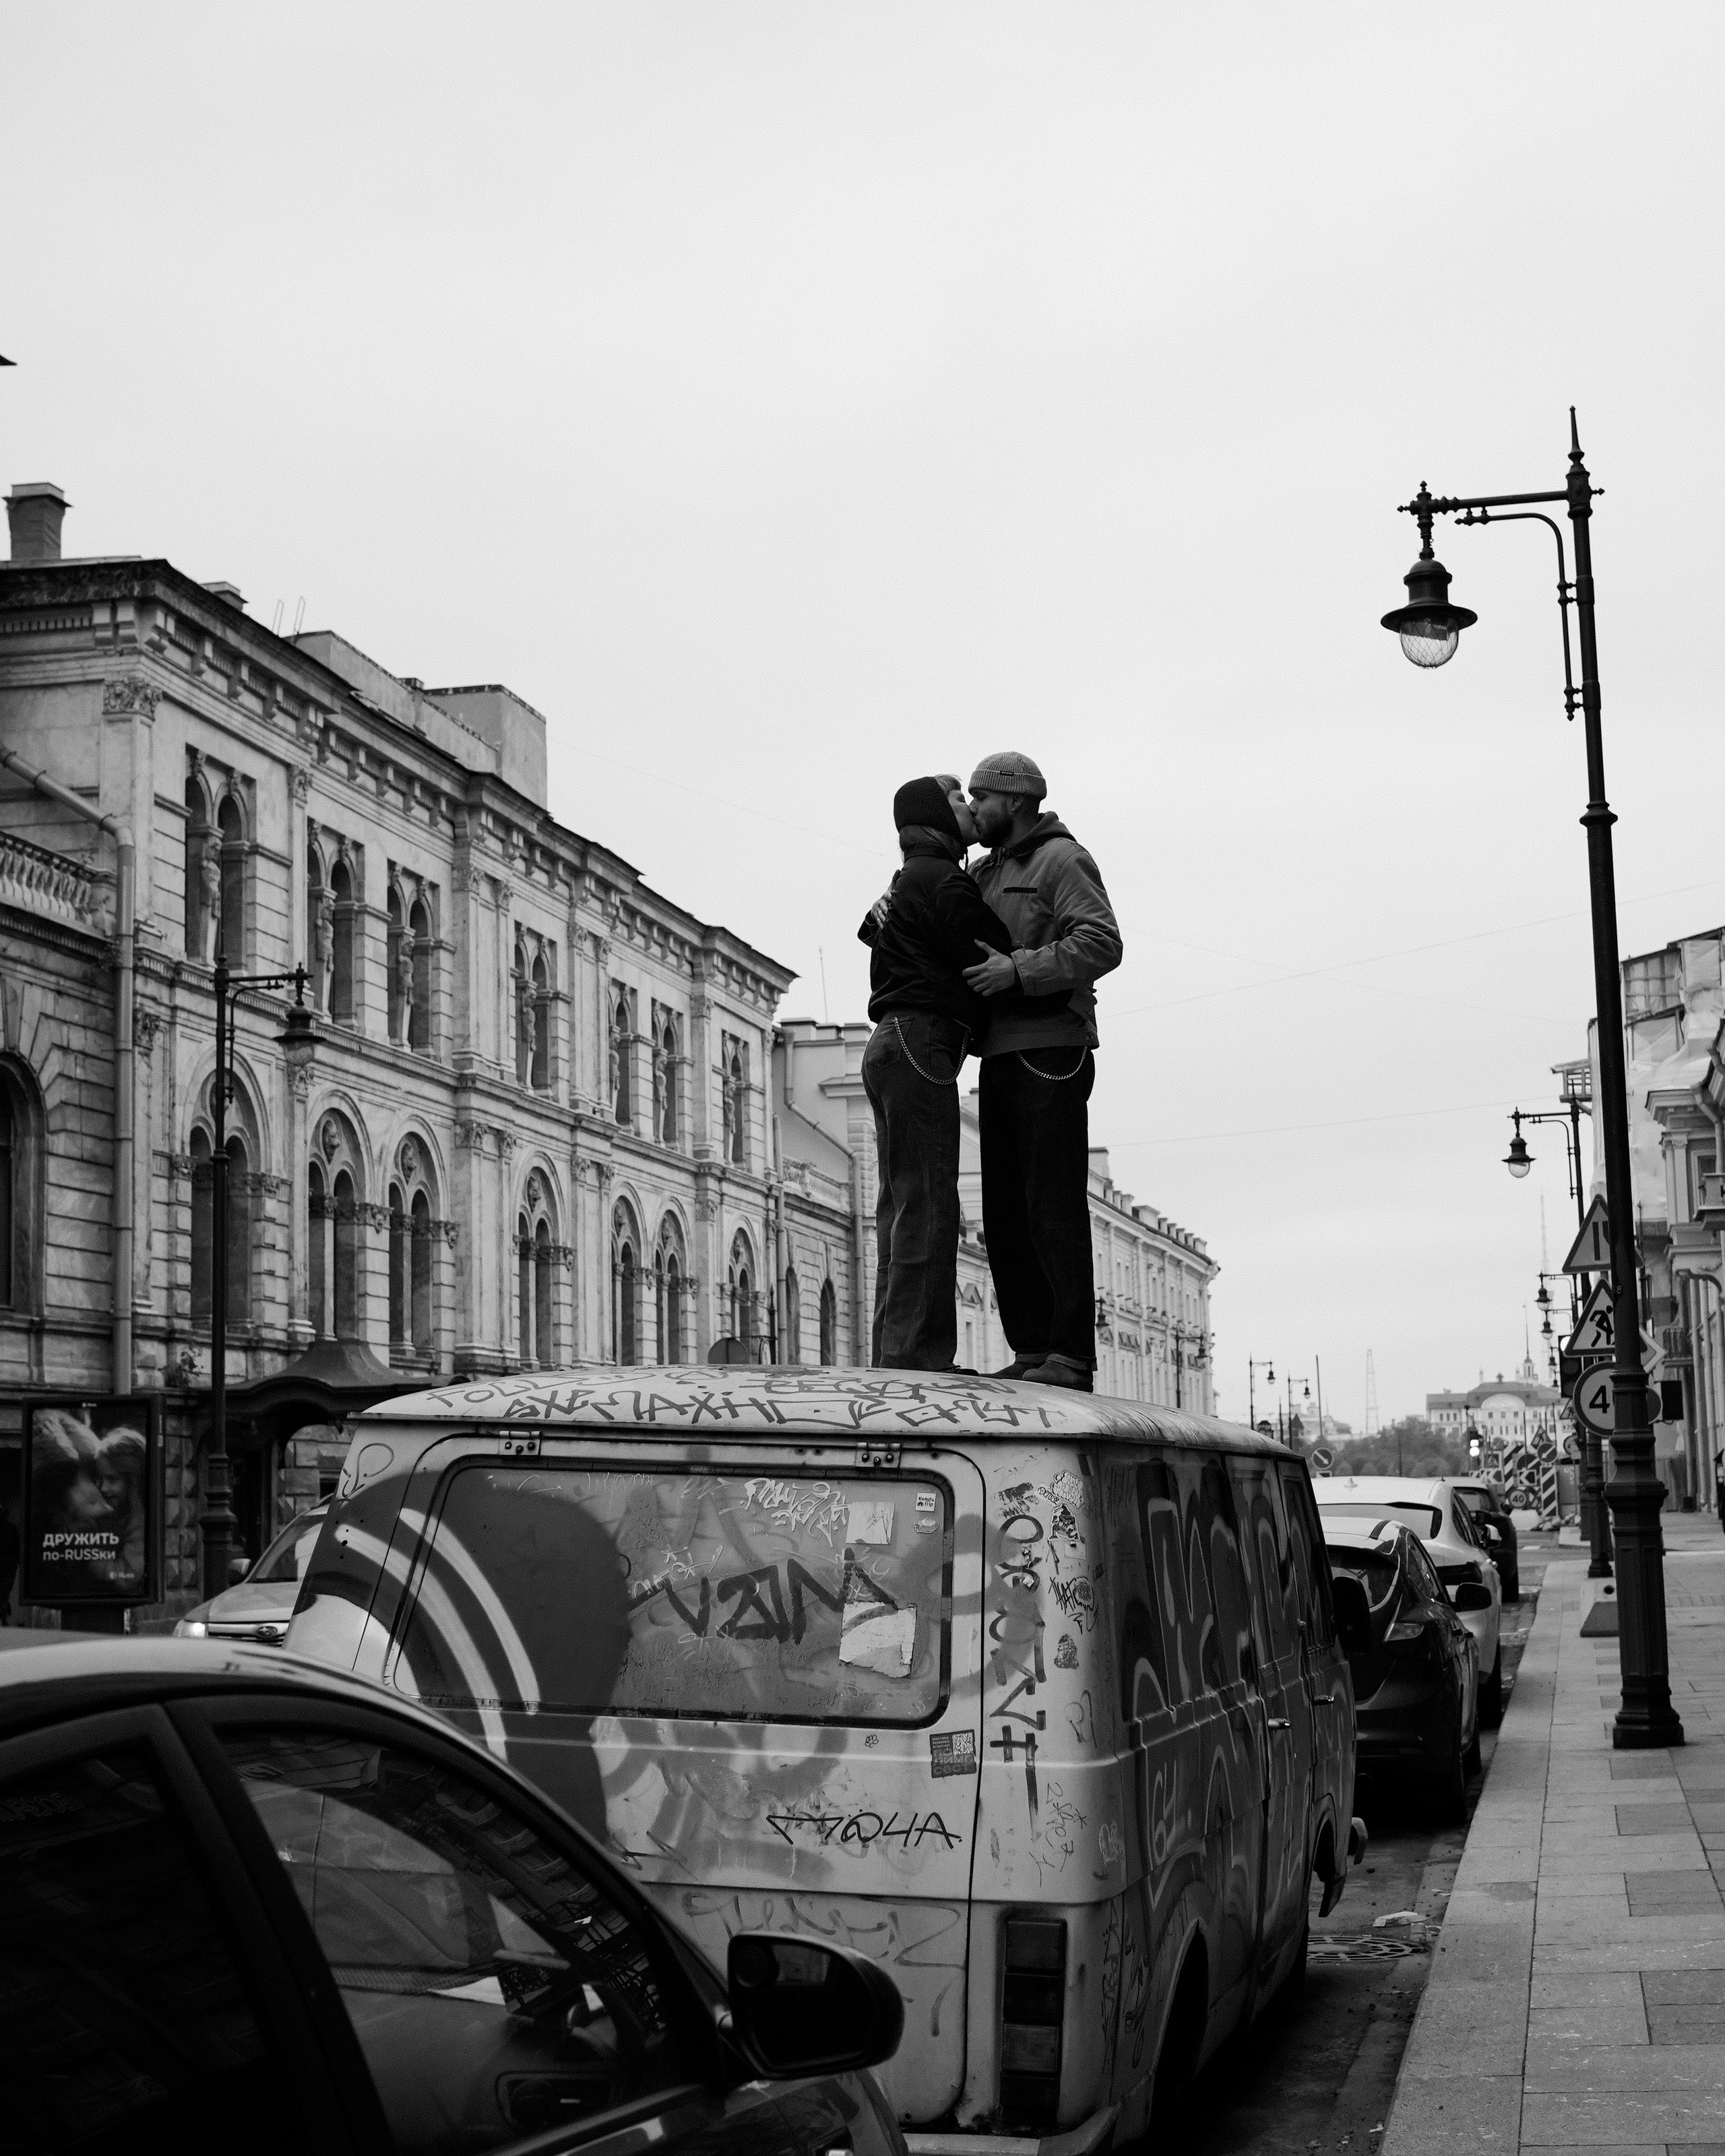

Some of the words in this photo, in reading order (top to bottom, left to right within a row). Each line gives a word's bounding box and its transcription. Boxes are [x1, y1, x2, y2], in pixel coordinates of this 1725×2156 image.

[1589, 1385, 1614, 1414] 4
[1512, 1494, 1524, 1503] 40
[42, 1533, 119, 1548] ДРУЖИТЬ
[43, 1548, 115, 1560] по-RUSSки
